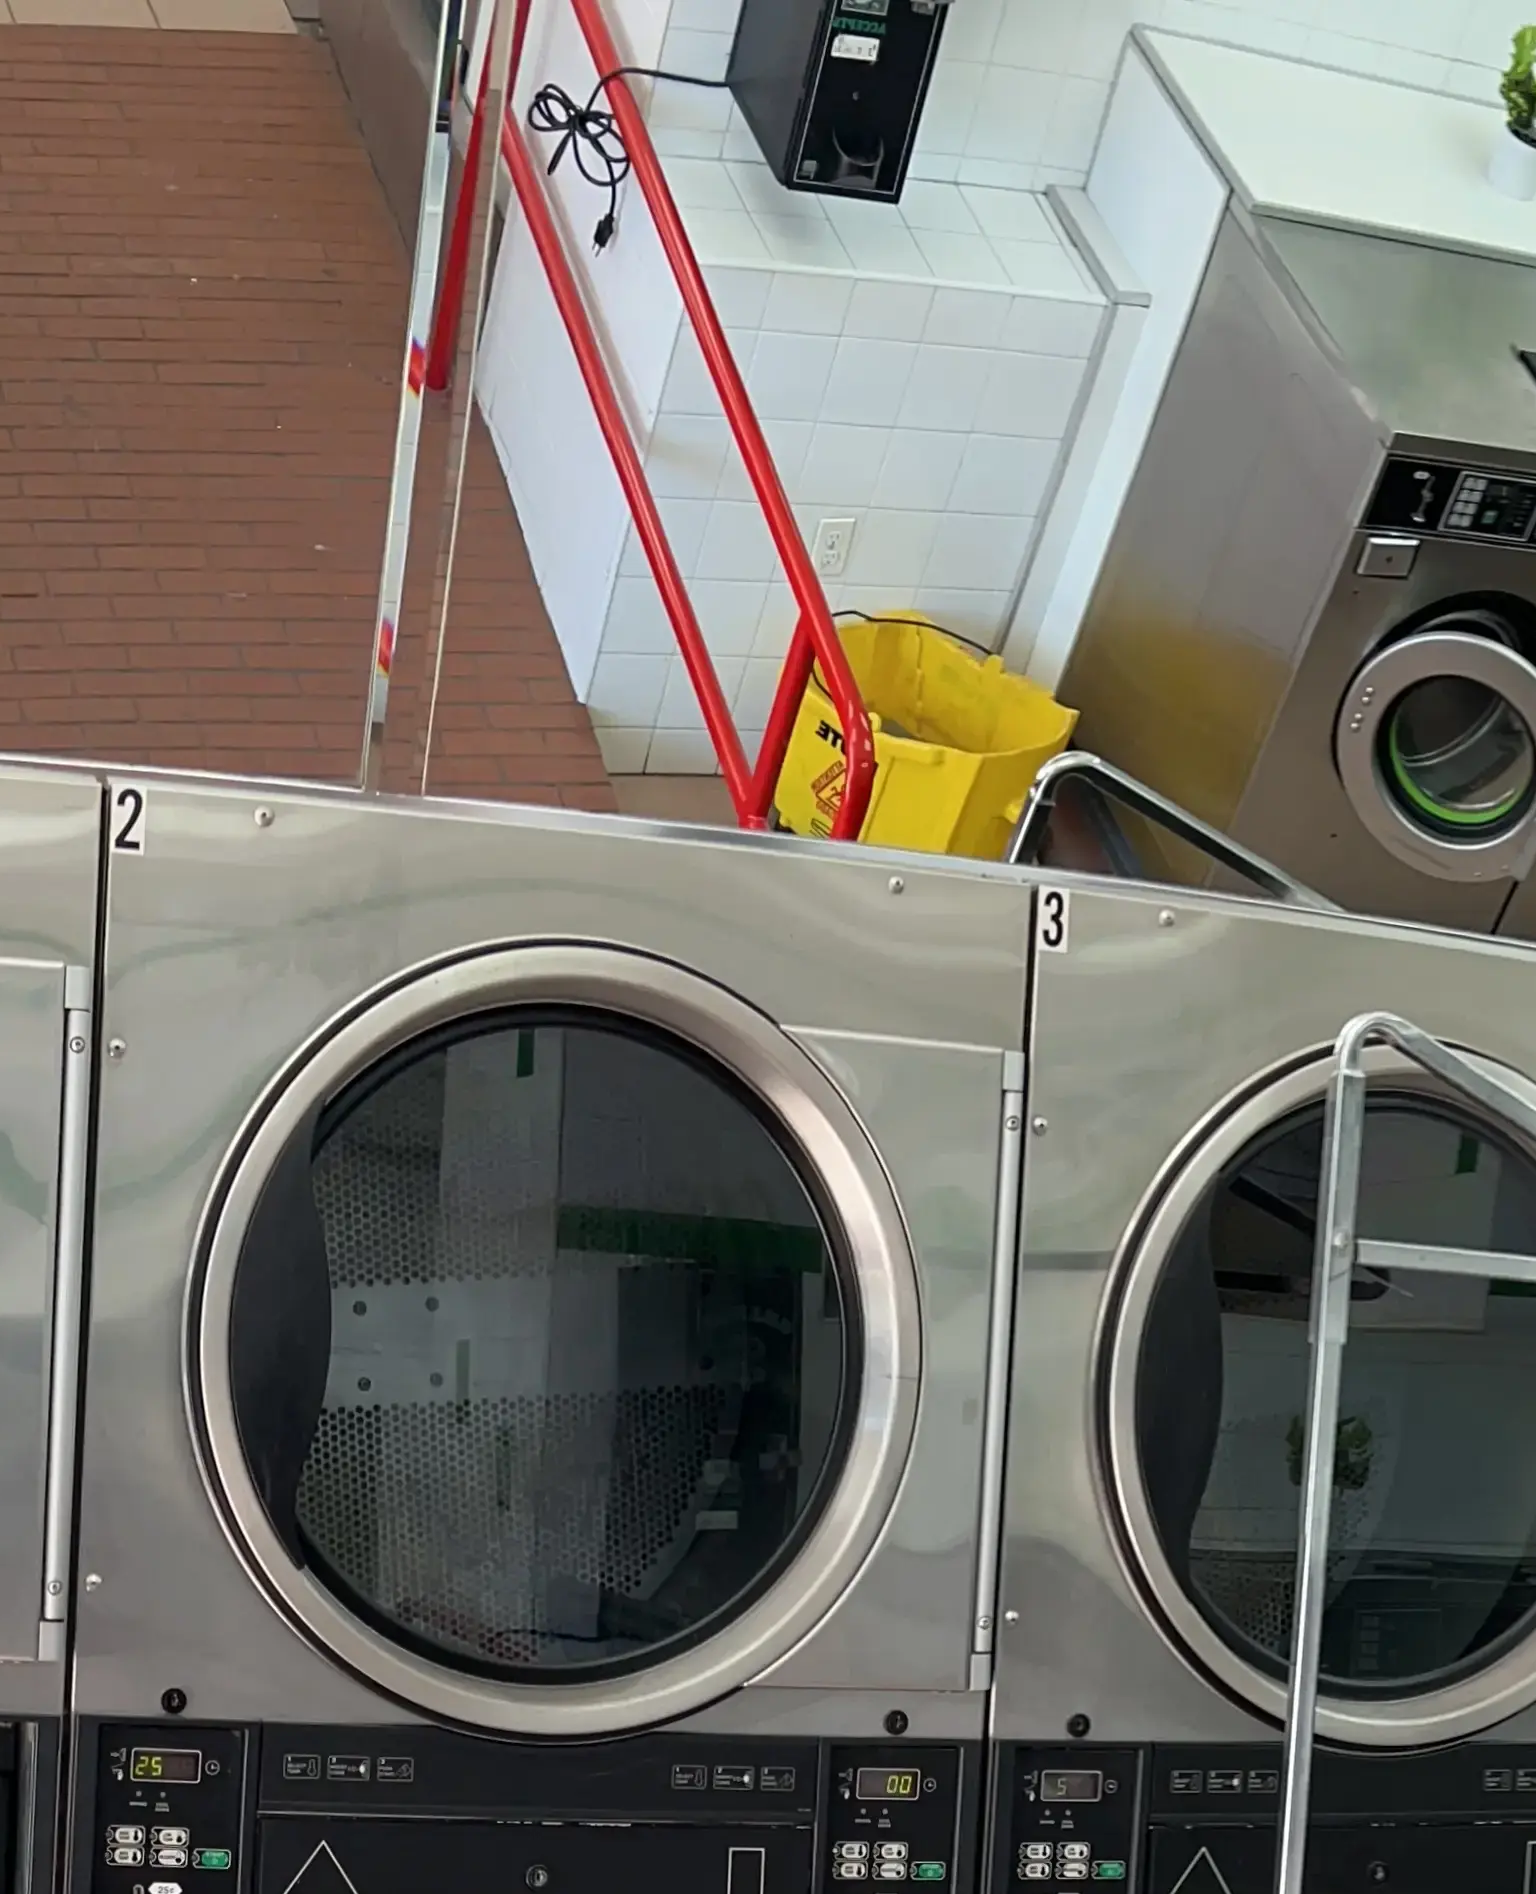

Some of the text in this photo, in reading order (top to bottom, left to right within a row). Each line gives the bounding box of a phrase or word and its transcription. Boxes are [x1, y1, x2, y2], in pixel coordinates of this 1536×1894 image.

[114, 788, 143, 850] 2
[1042, 890, 1064, 948] 3
[134, 1755, 163, 1777] 25
[886, 1774, 912, 1795] 00
